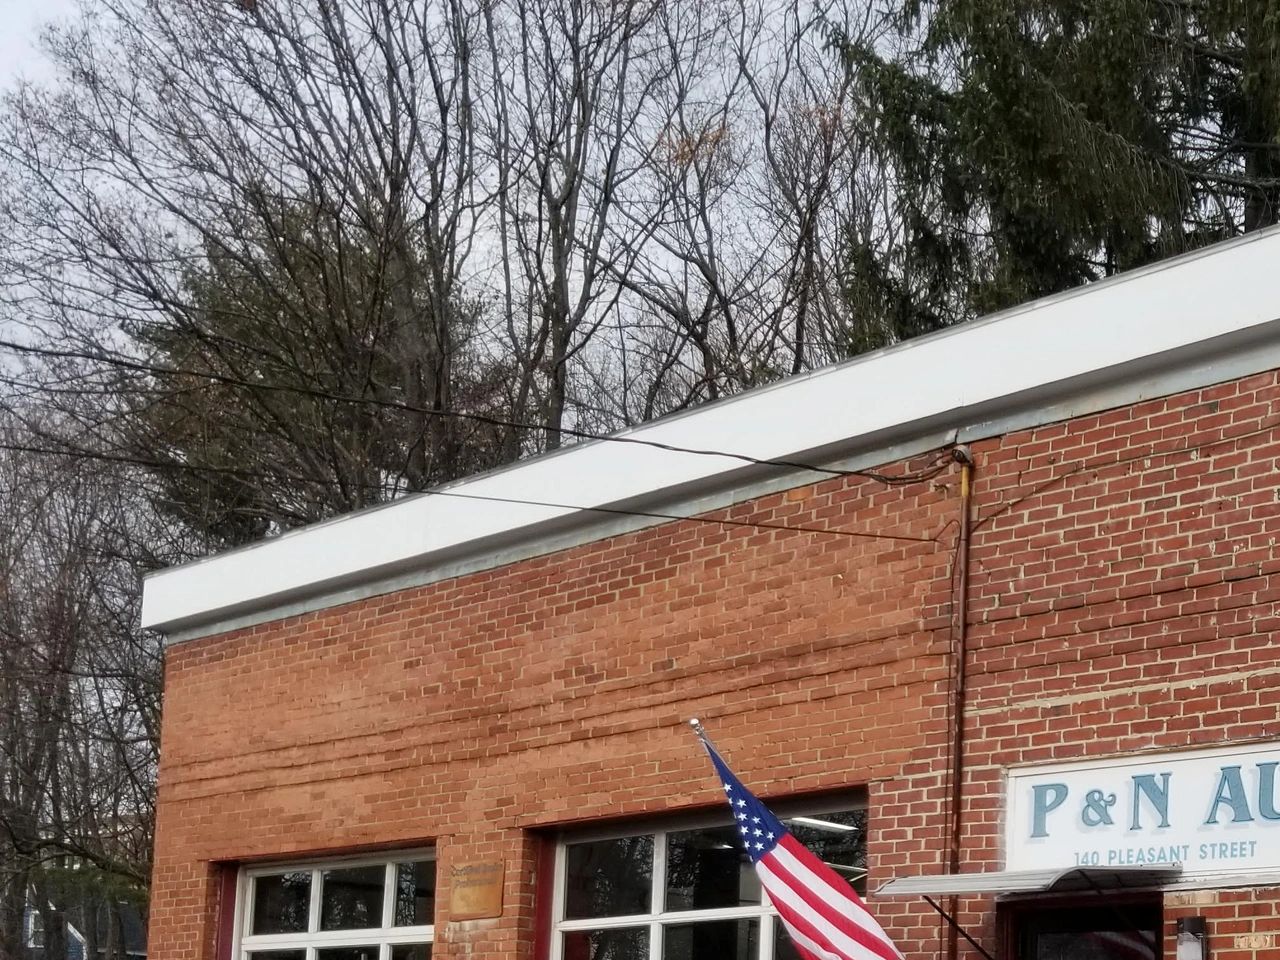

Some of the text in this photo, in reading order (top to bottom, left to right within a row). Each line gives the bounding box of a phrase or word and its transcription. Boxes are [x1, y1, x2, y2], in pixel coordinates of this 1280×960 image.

[1074, 840, 1257, 866] 140 PLEASANT STREET
